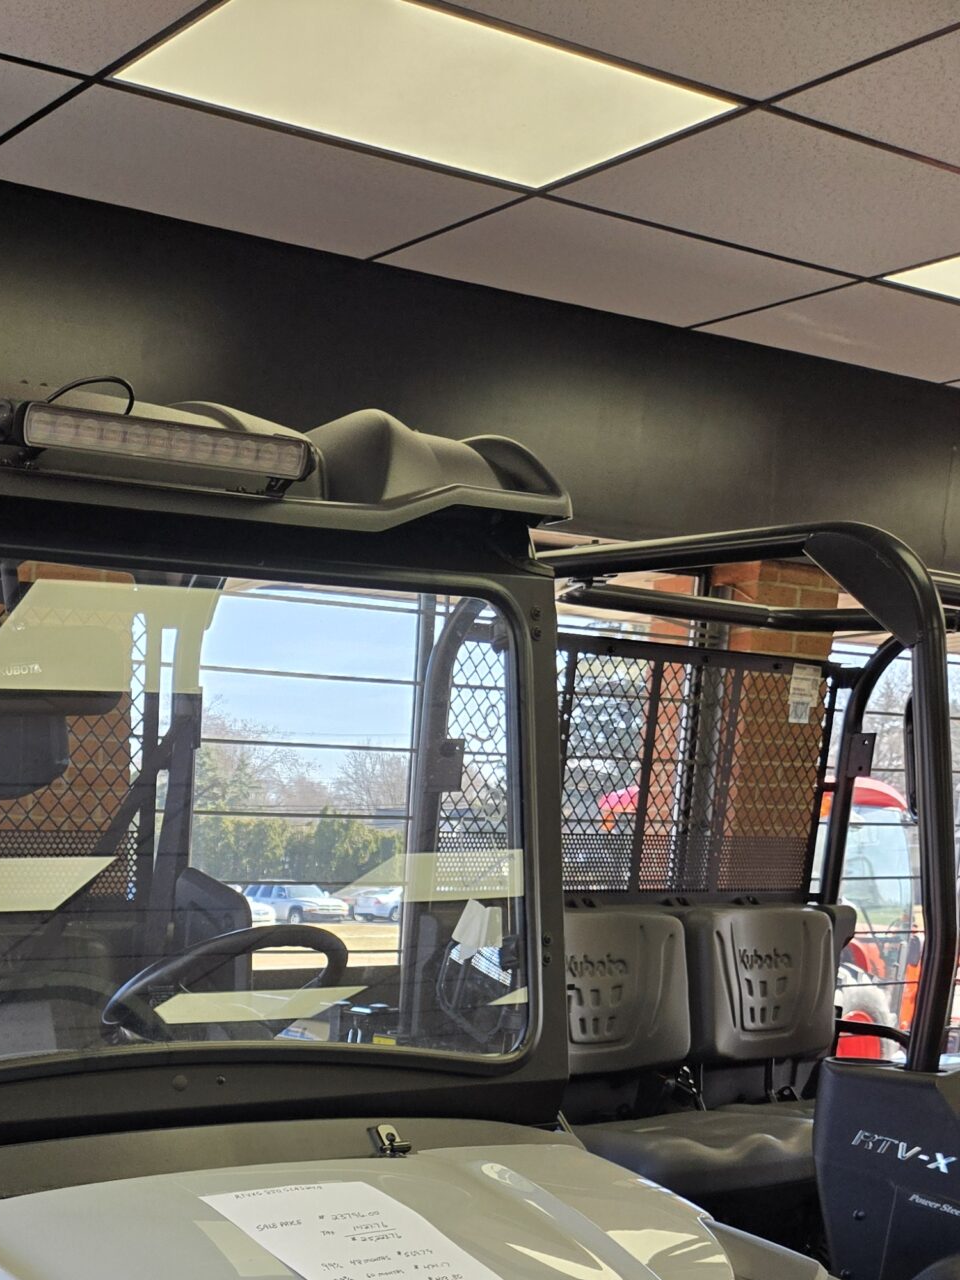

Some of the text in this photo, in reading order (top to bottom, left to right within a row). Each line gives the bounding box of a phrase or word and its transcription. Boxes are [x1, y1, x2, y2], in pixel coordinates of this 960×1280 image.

[851, 1129, 958, 1174] RTV-X
[908, 1193, 940, 1209] Power
[255, 1222, 278, 1232] SALE
